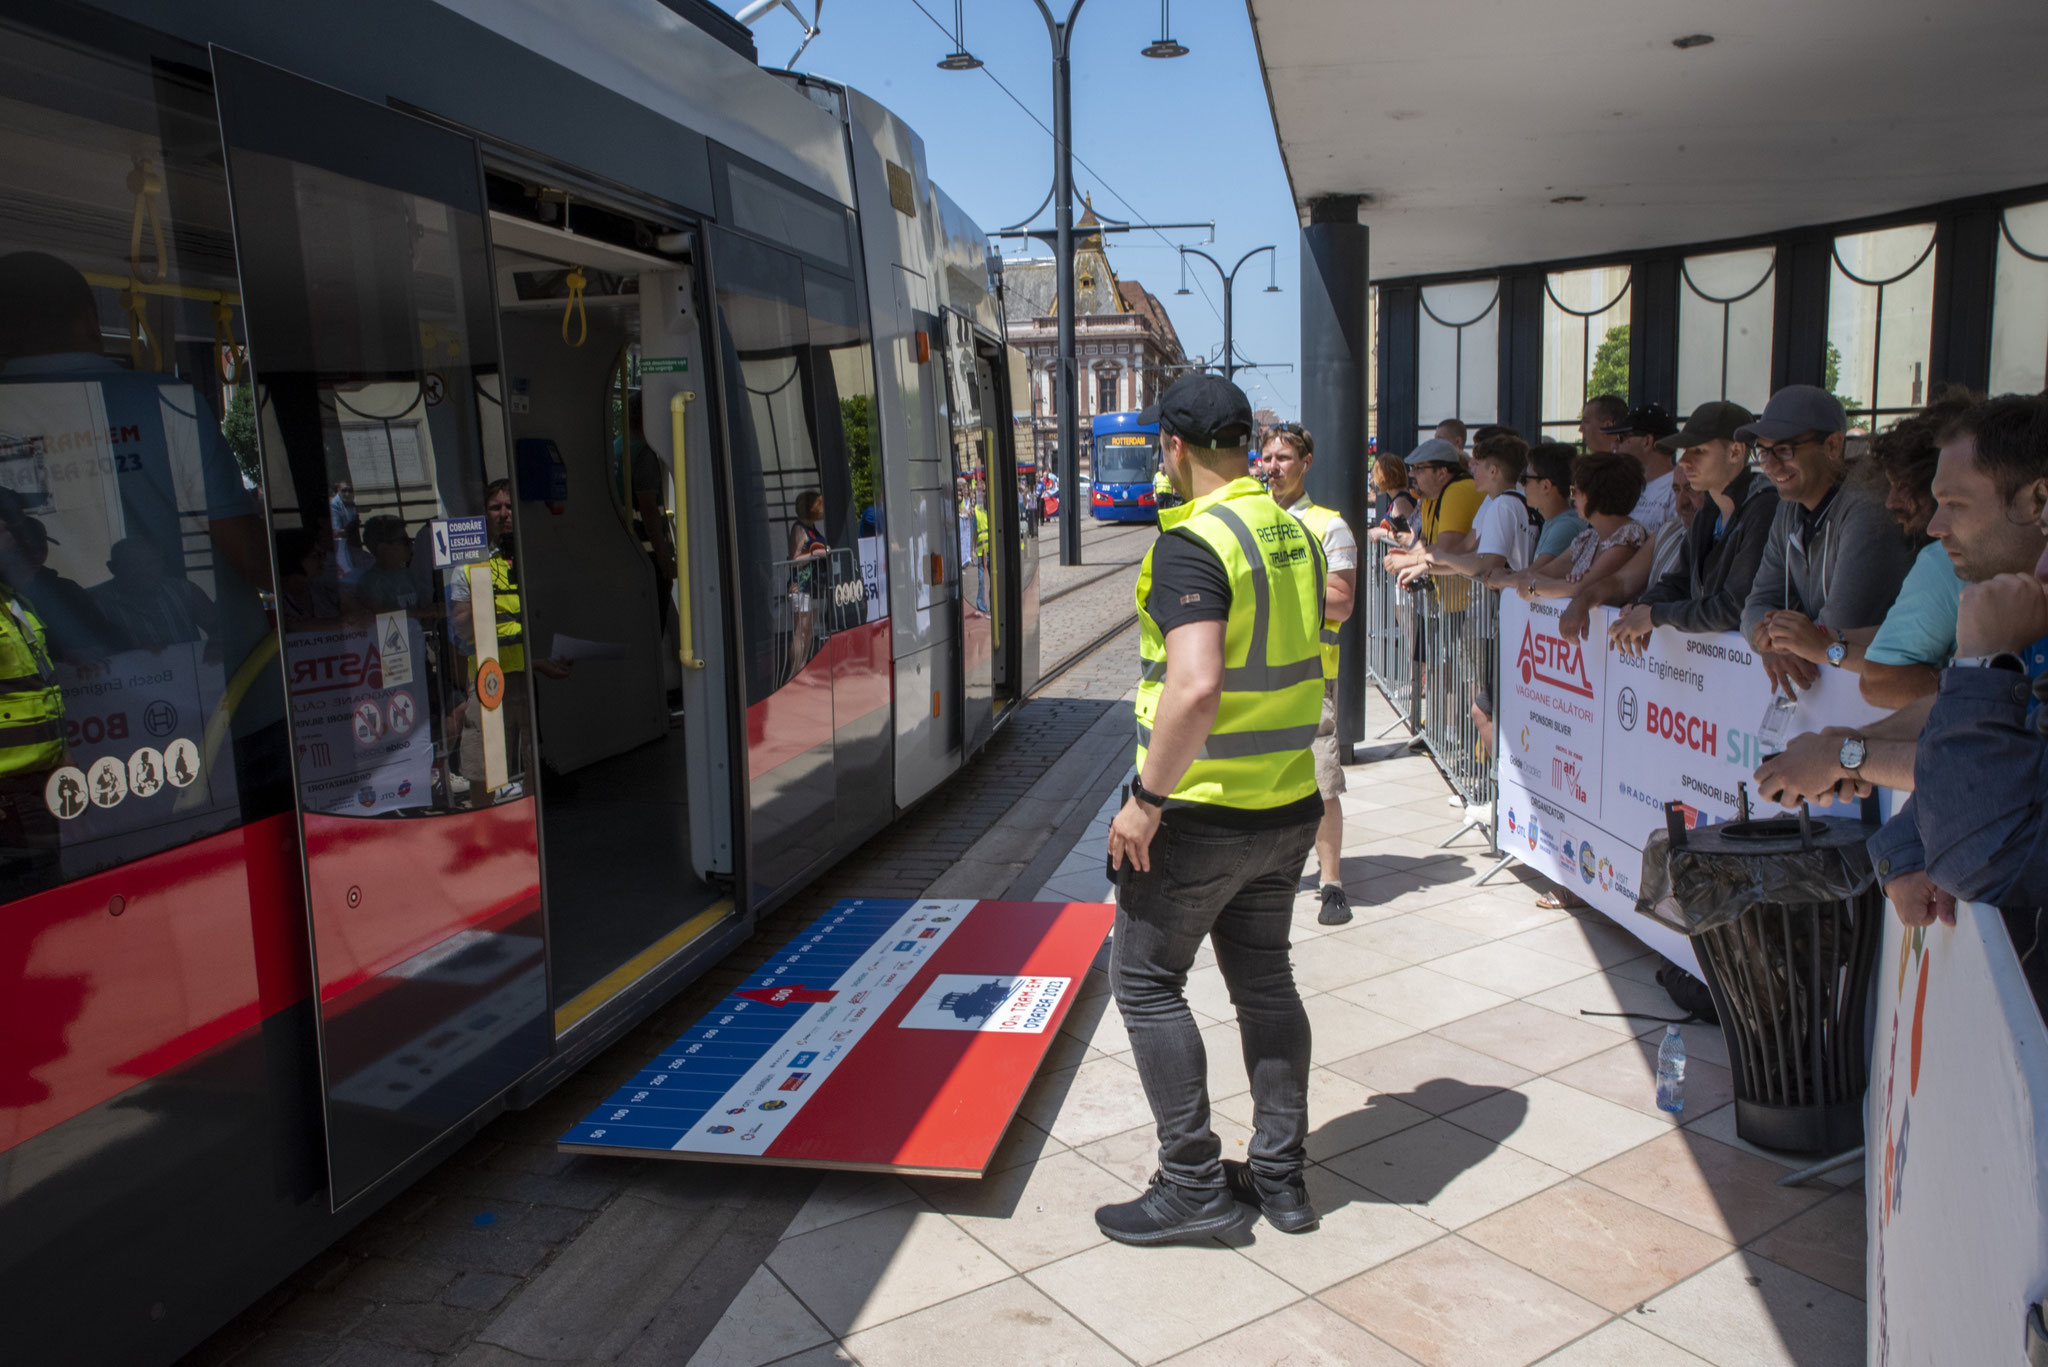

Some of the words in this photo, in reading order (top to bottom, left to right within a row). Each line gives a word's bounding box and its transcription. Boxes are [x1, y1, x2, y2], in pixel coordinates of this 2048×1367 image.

[1111, 437, 1146, 446] ROTTERDAM
[449, 520, 483, 532] COBORÂRE
[451, 535, 482, 548] LESZÁLLÁS
[452, 551, 464, 561] EXIT
[464, 550, 480, 560] HERE
[1530, 602, 1554, 617] SPONSOR
[1516, 618, 1594, 700] ASTRA
[1686, 639, 1727, 660] SPONSORI
[1728, 648, 1752, 666] GOLD
[1648, 656, 1704, 692] Engineering
[1516, 684, 1551, 707] VAGOANE
[1552, 696, 1594, 723] CĂLĂTORI
[1529, 710, 1554, 729] SPONSORI
[1554, 721, 1572, 737] SILVER
[1646, 701, 1718, 758] BOSCH
[1626, 786, 1665, 812] RADCOM
[1681, 774, 1722, 801] SPONSORI
[1724, 792, 1755, 815] BROZ
[1530, 796, 1565, 823] ORGANIZATORI
[771, 988, 793, 1002] 500
[1010, 978, 1044, 1012] TRAM-EM
[1023, 998, 1054, 1029] ORADEA
[1042, 980, 1064, 997] 2023
[999, 1015, 1022, 1030] 10th
[668, 1058, 686, 1069] 250
[649, 1074, 668, 1086] 200
[630, 1091, 649, 1102] 150
[610, 1108, 629, 1121] 100
[589, 1129, 607, 1139] 50
